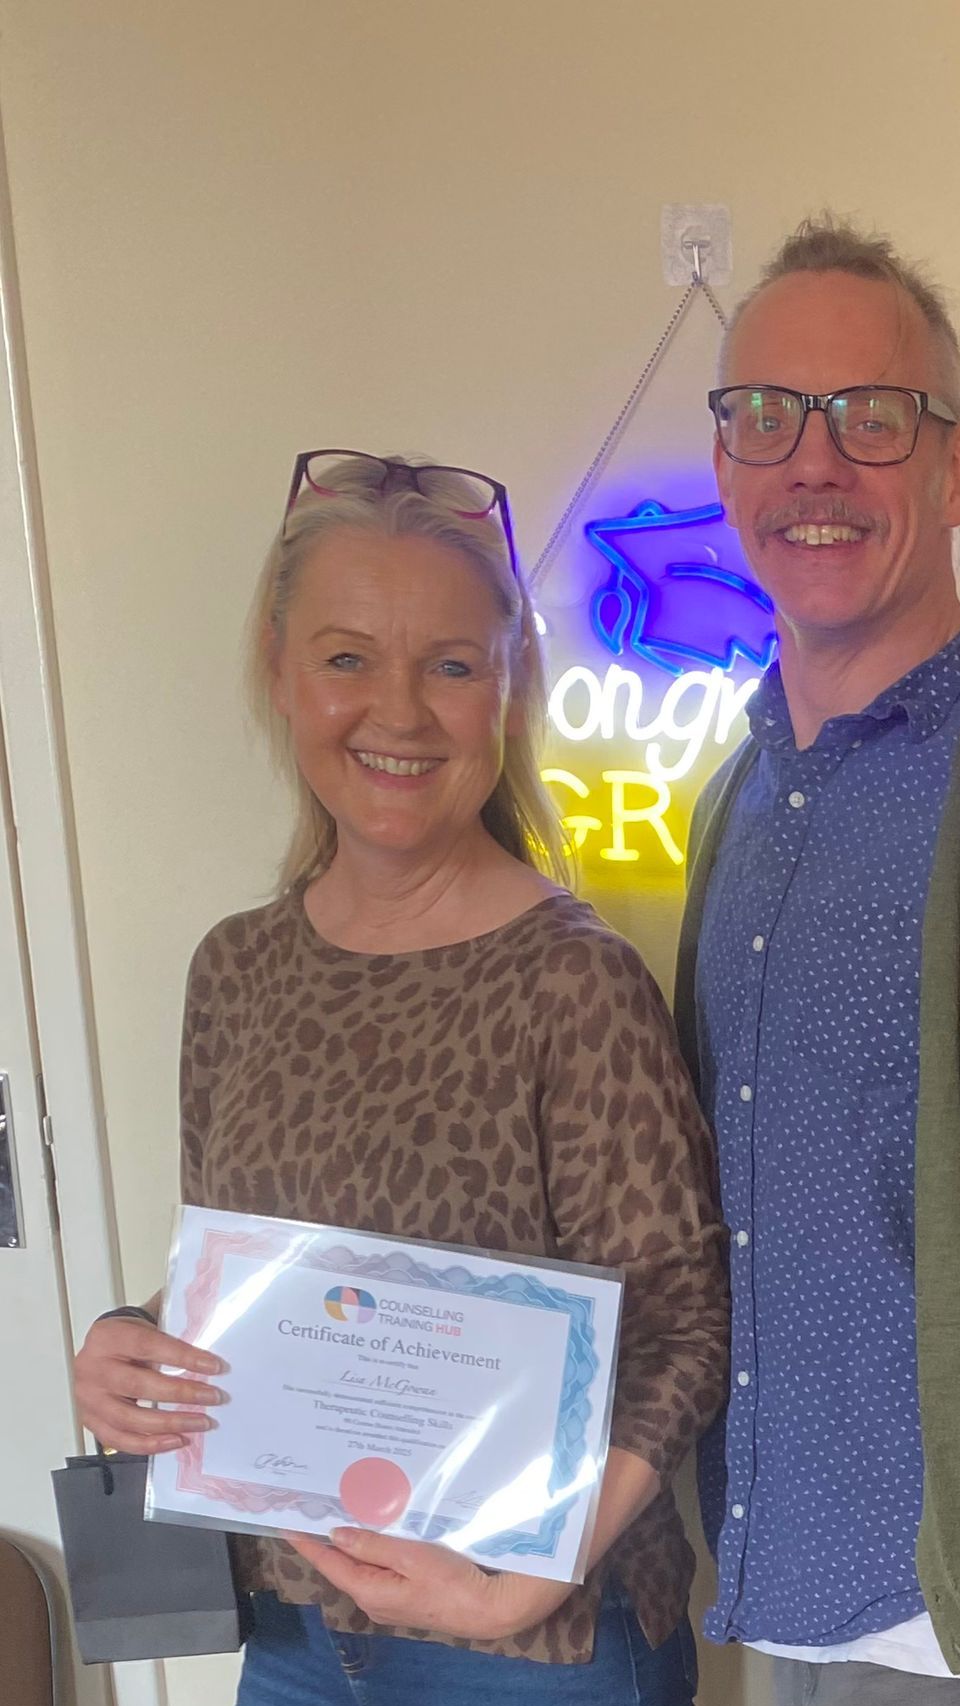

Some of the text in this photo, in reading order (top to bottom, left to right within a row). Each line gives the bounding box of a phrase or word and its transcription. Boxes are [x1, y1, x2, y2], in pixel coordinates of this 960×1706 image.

[378, 1298, 464, 1323] COUNSELLING
[377, 1312, 462, 1337] TRAINING HUB
[278, 1319, 501, 1370] Certificate of Achievement
[340, 1370, 366, 1384] Lisa
